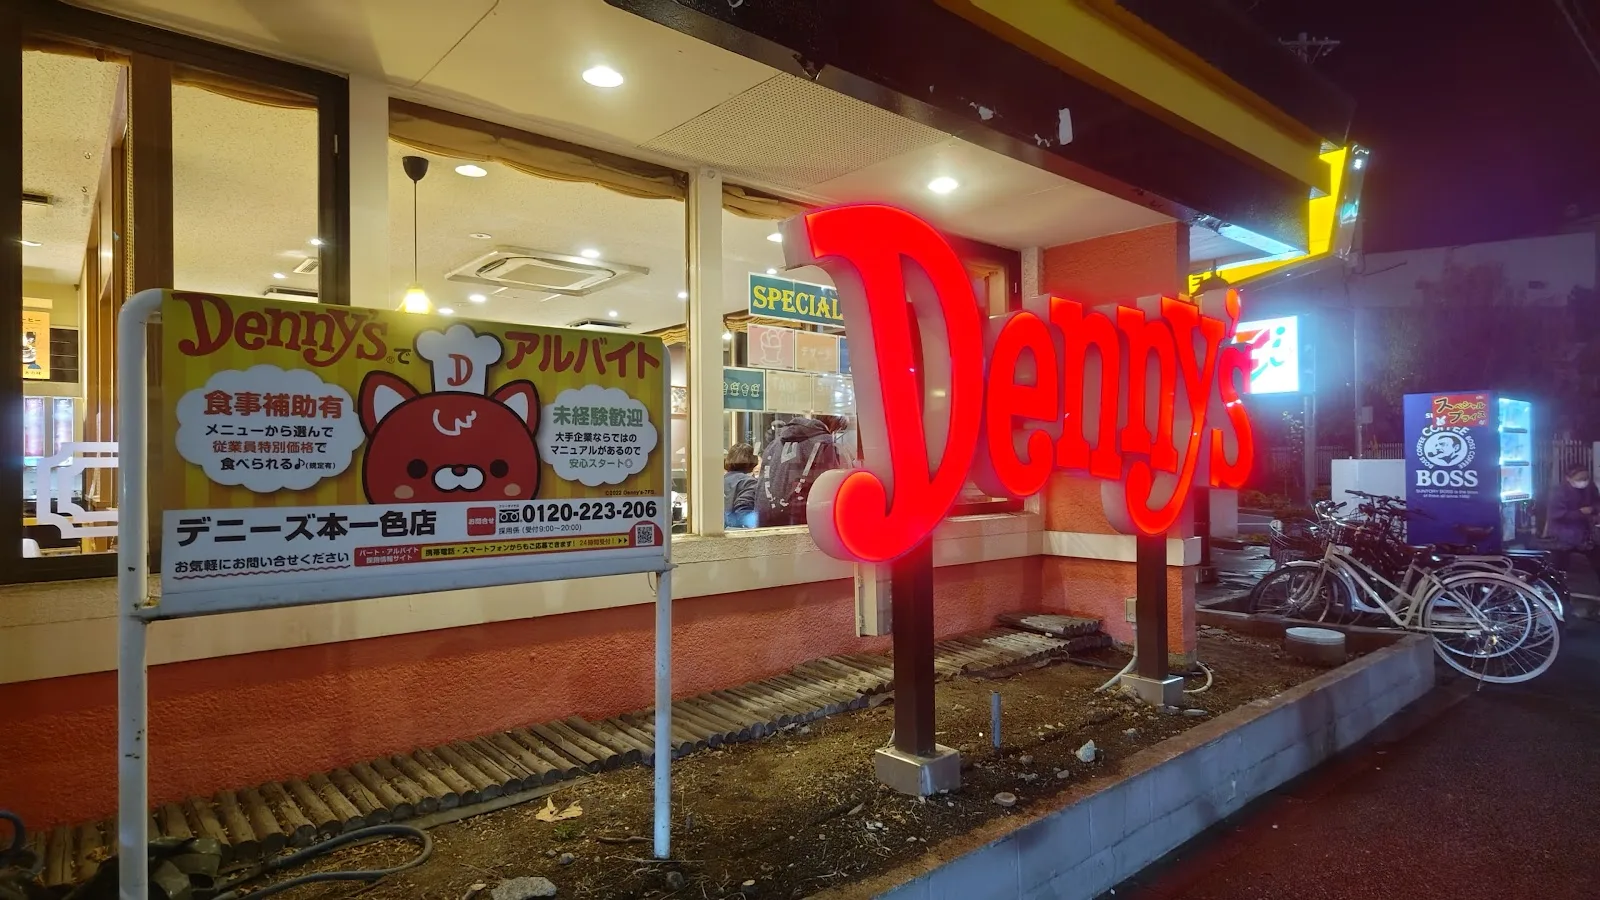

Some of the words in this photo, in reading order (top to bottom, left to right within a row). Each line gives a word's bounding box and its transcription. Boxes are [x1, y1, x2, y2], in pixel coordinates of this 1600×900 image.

[753, 285, 844, 320] SPECIAL
[171, 293, 388, 367] Denny's
[394, 348, 411, 365] で
[505, 331, 660, 379] アルバイト
[447, 353, 473, 386] D
[805, 203, 1254, 563] Denny's
[203, 390, 344, 419] 食事補助有
[553, 405, 643, 427] 未経験歓迎
[205, 424, 334, 438] メニューから選んで
[555, 432, 637, 443] 大手企業ならではの
[213, 440, 327, 454] 従業員特別価格で
[550, 445, 641, 456] マニュアルがあるので
[1415, 469, 1478, 487] BOSS
[468, 517, 495, 525] お問合せ
[522, 501, 657, 523] 0120-223-206
[177, 510, 437, 547] デニーズ本一色店
[174, 552, 349, 573] お気軽にお問い合せください
